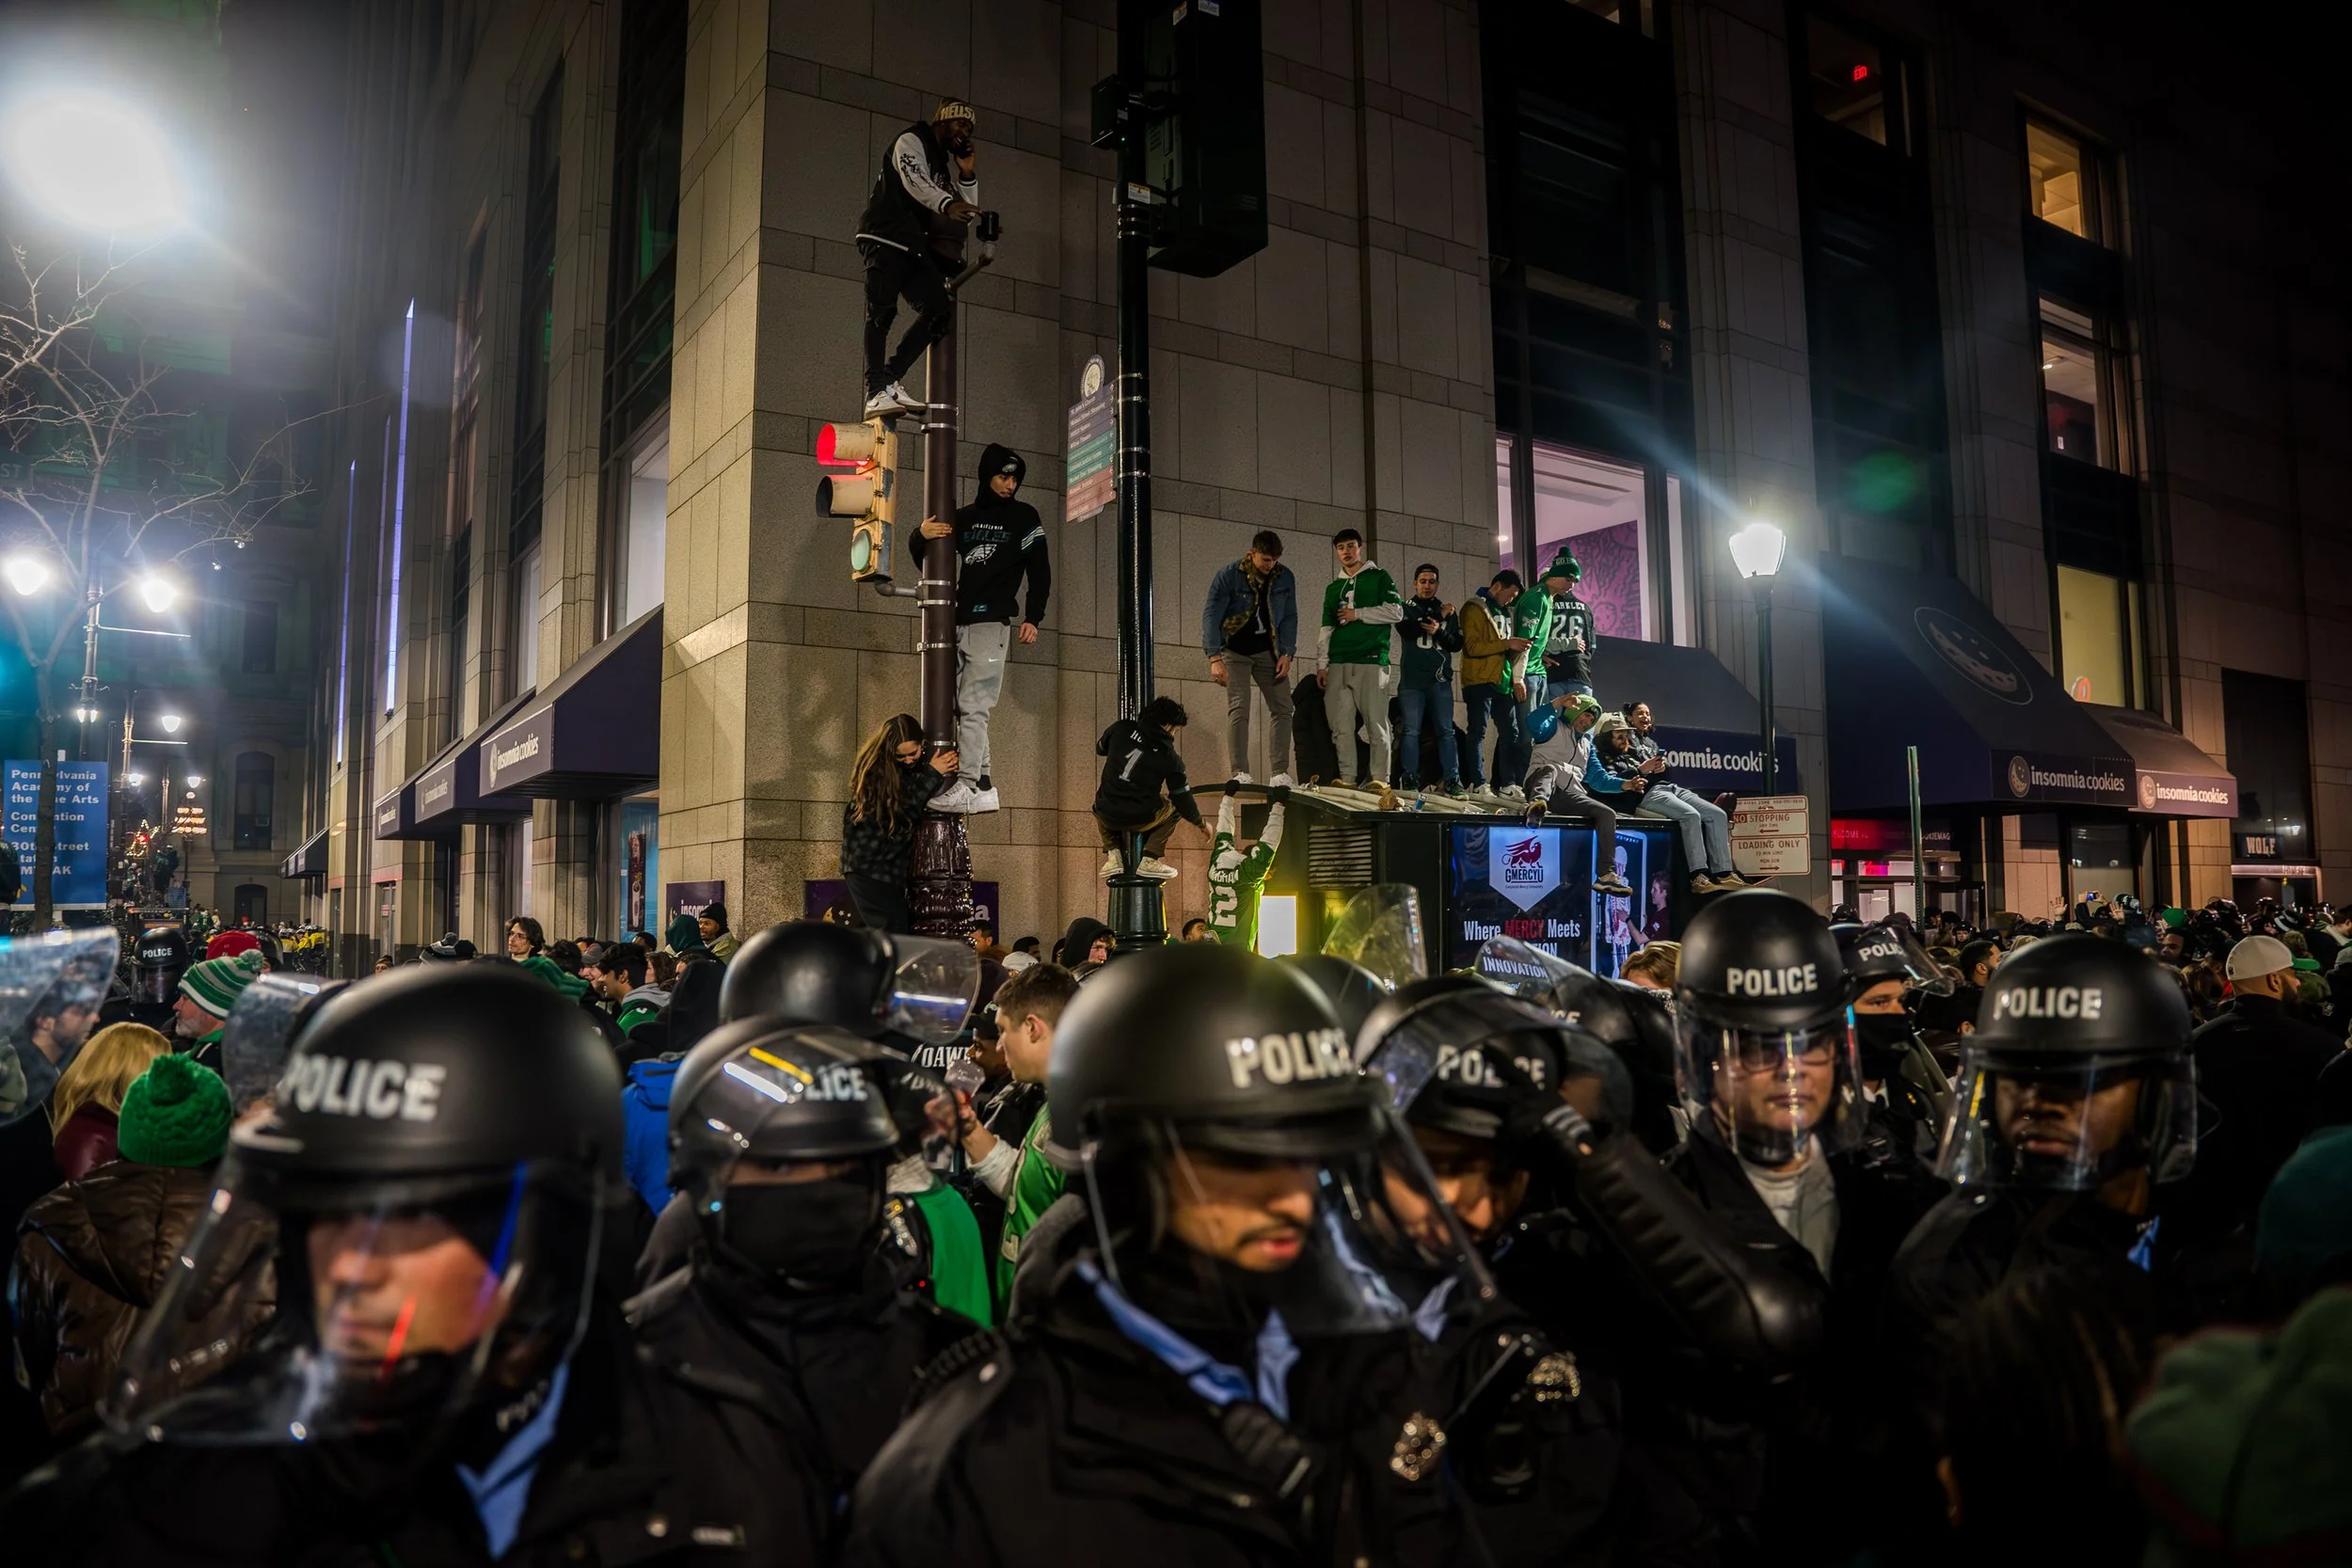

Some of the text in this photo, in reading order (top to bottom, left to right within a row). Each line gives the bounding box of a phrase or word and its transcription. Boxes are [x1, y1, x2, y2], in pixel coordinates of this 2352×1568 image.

[1552, 601, 1586, 610] ARKLEY
[1551, 614, 1583, 639] 26
[1118, 748, 1144, 782] 1
[1664, 747, 1779, 773] omnia cookis
[11, 769, 97, 780] Pennlvania
[2031, 765, 2125, 792] insomnia cookies
[12, 782, 90, 793] Acamy of
[2156, 783, 2229, 805] insomnia cookies
[11, 794, 33, 803] the
[72, 795, 100, 804] Arts
[10, 812, 85, 821] Conntion
[1749, 814, 1790, 823] STOPPING
[11, 842, 89, 851] 30t treet
[1739, 840, 1801, 849] LOADING ONLY
[1505, 869, 1544, 883] GMERCYU
[1464, 919, 1581, 941] Where MERCY Meets
[142, 947, 172, 958] POLICE
[1483, 957, 1549, 979] INNOVATION
[1726, 962, 1818, 998] POLICE
[1994, 987, 2103, 1021] POLICE
[281, 1052, 447, 1121] POLICE
